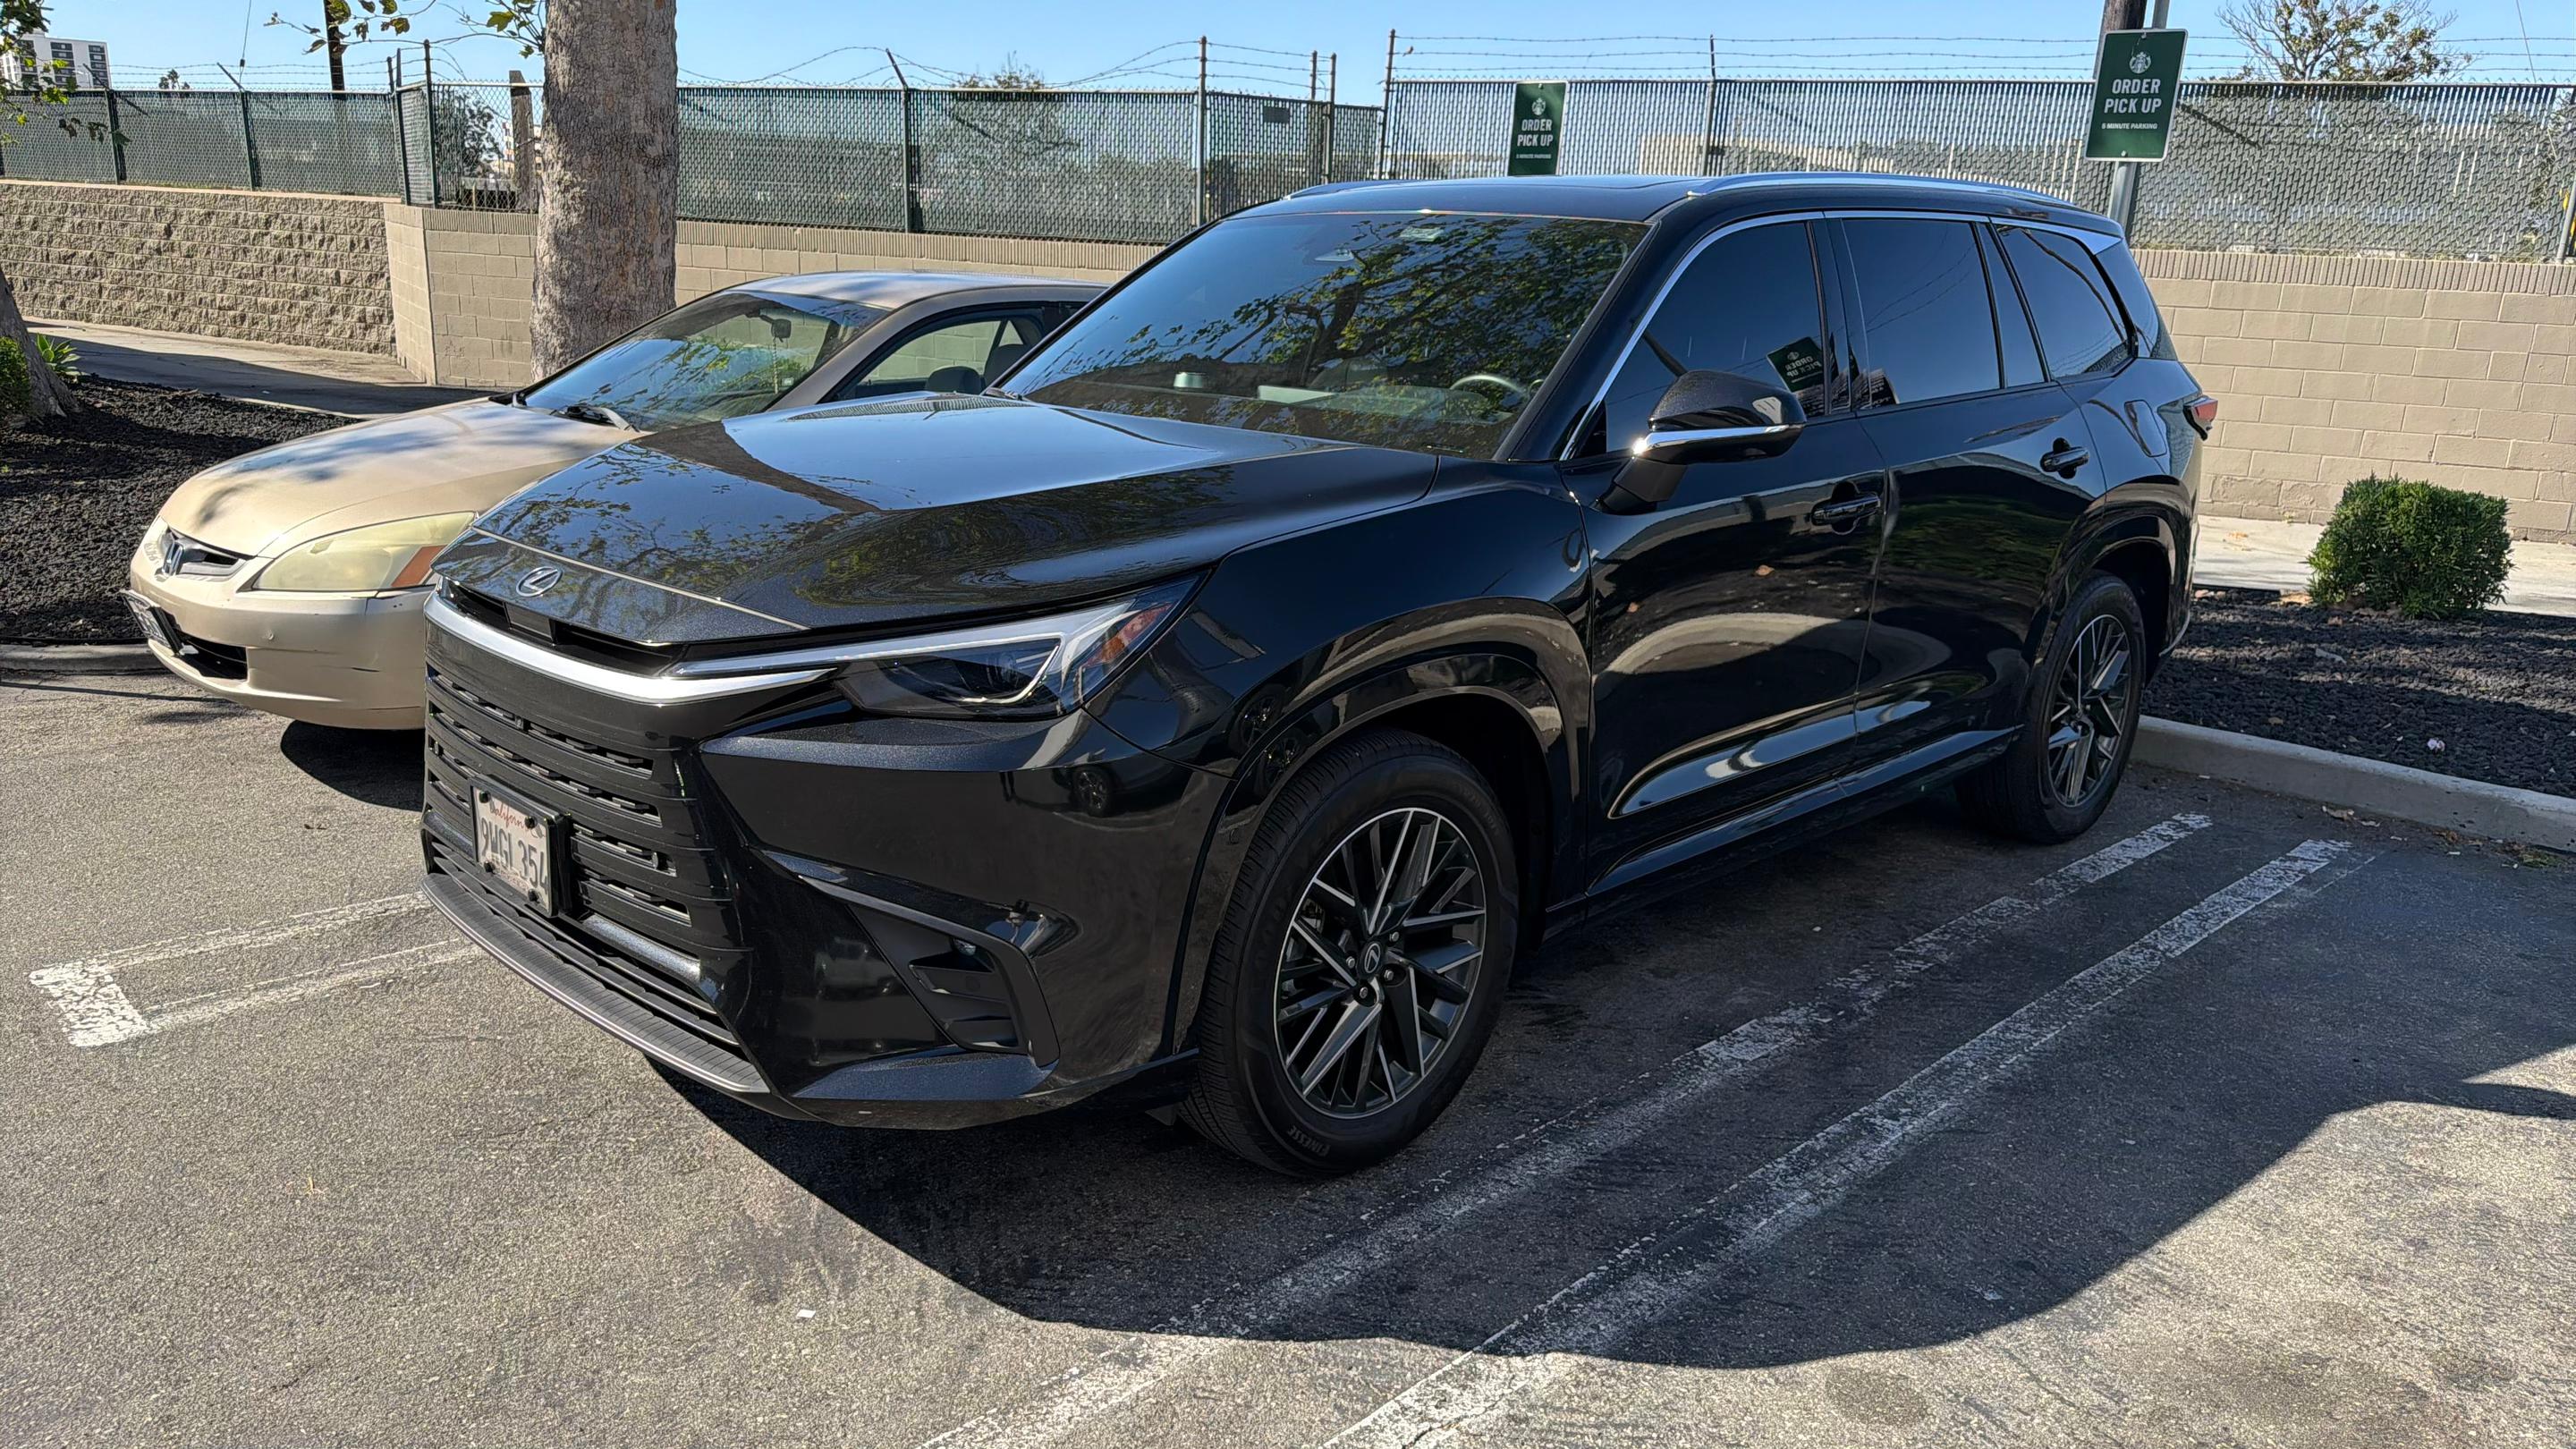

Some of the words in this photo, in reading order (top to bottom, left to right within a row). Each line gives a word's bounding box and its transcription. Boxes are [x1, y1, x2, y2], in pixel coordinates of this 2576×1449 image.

[2112, 79, 2161, 94] ORDER
[2104, 98, 2139, 114] PICK
[2141, 98, 2162, 114] UP
[1521, 119, 1553, 131] ORDER
[1517, 134, 1538, 147] PICK
[1540, 134, 1554, 147] UP
